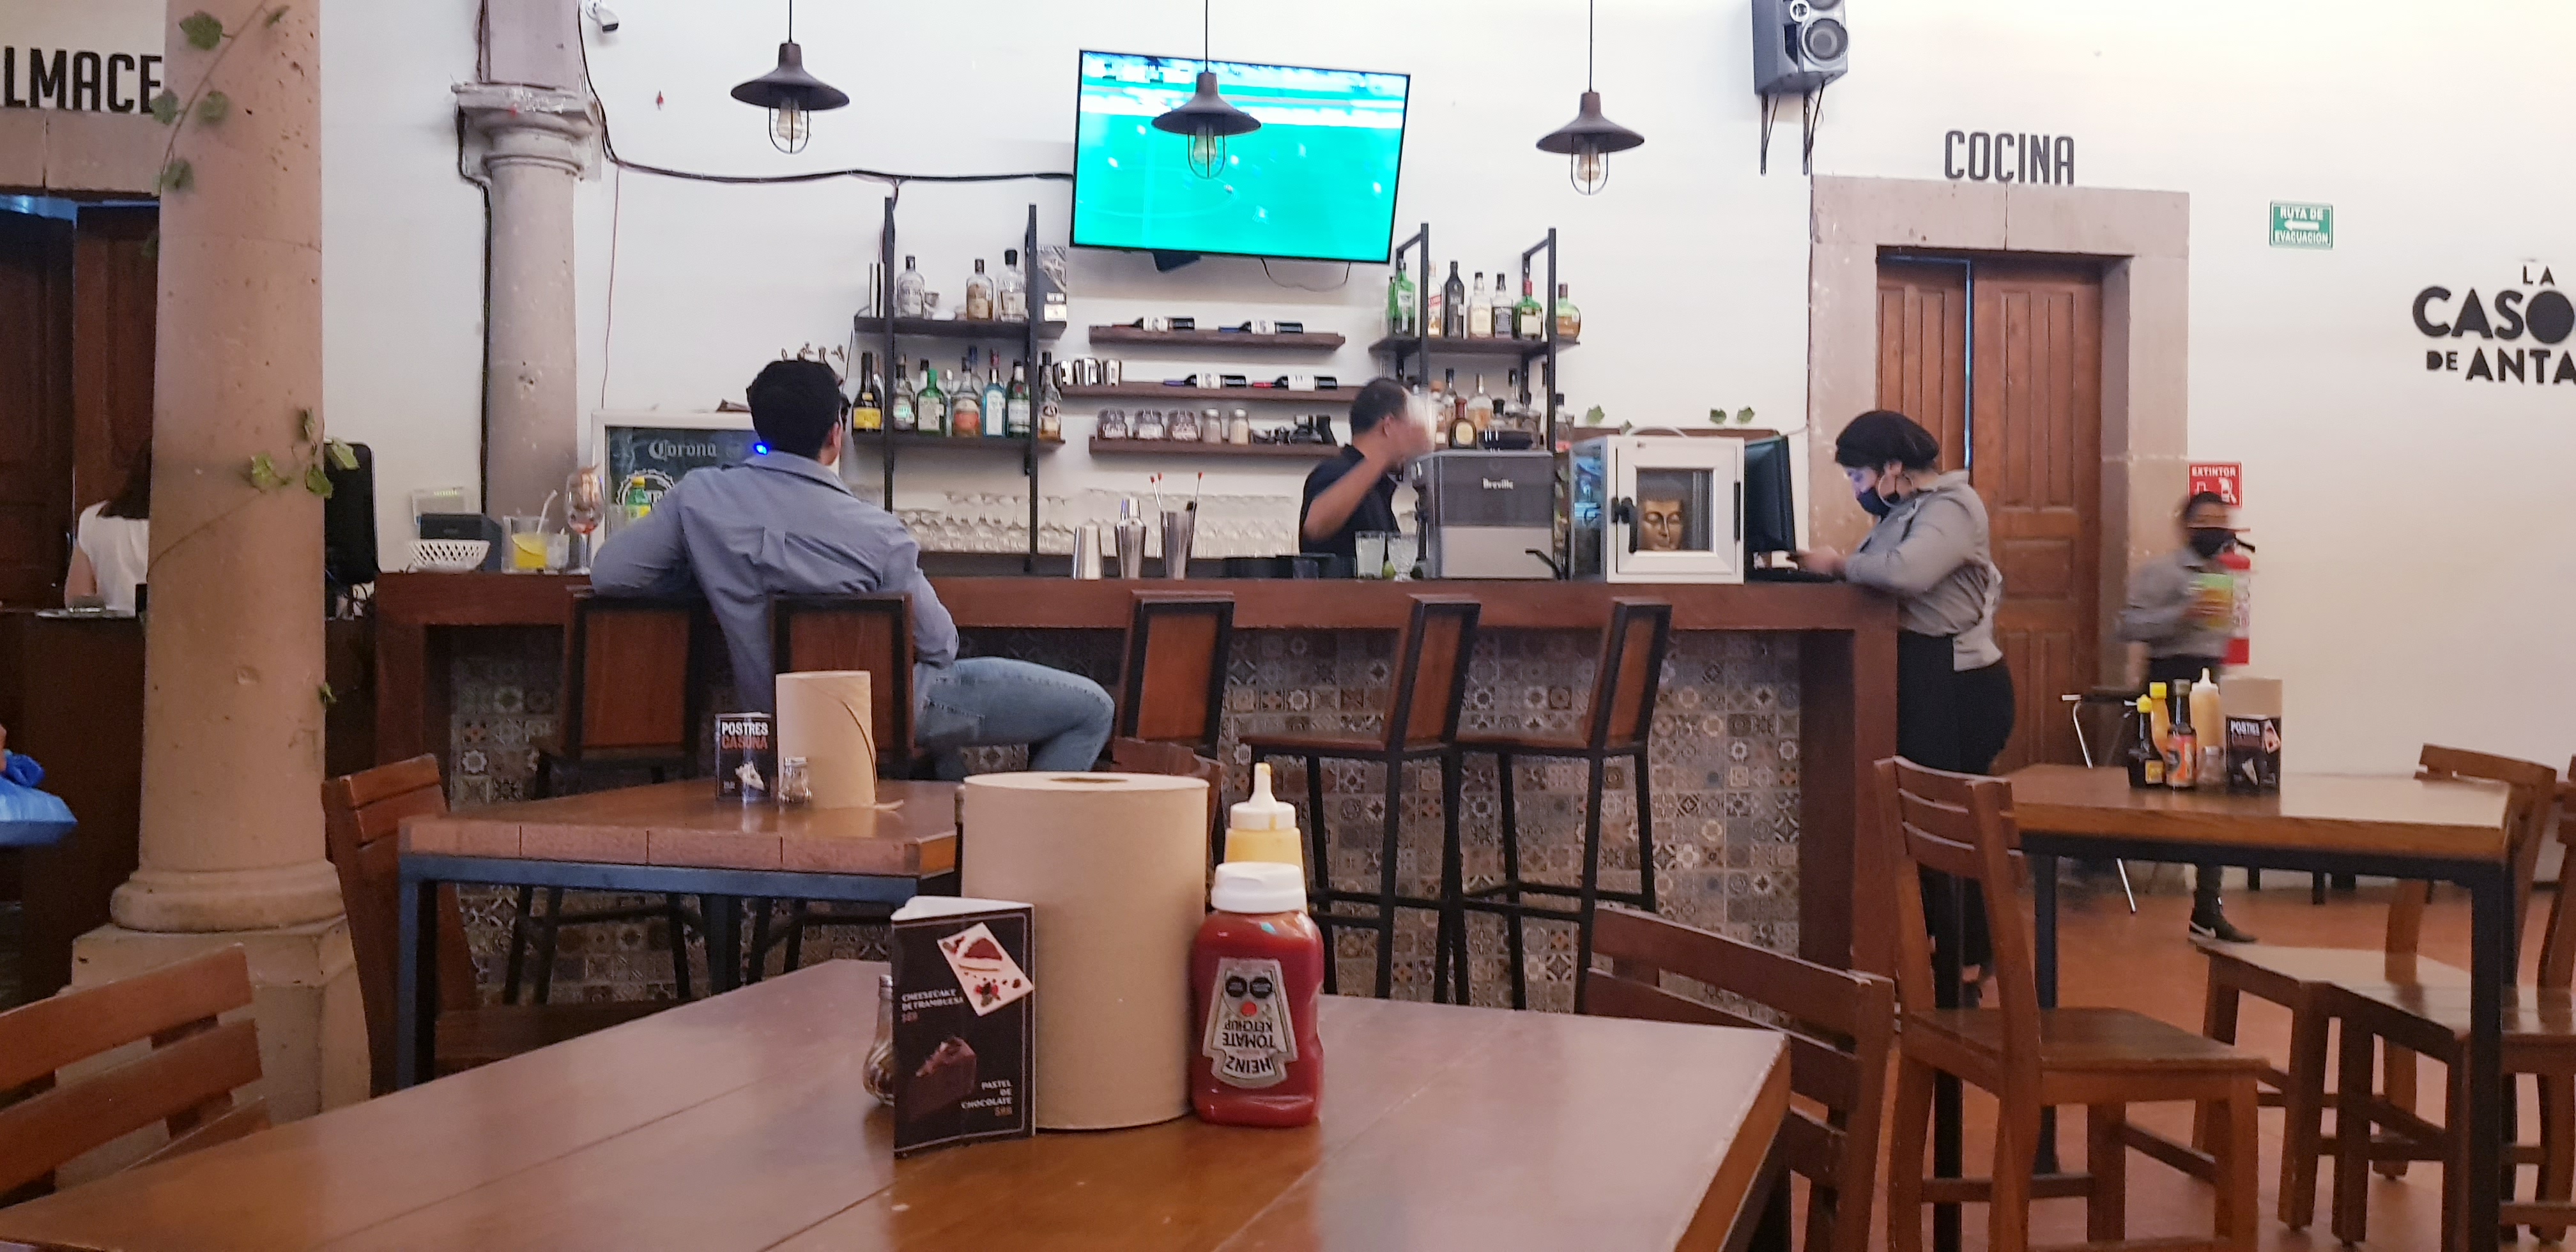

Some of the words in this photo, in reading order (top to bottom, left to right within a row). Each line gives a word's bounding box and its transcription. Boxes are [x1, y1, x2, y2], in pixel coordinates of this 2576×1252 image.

[1945, 130, 2074, 186] COCINA
[2280, 206, 2307, 220] RUTA
[2310, 207, 2324, 220] DE
[2523, 264, 2555, 286] LA
[2412, 286, 2575, 345] CASO
[2426, 349, 2458, 370] DE
[2465, 346, 2576, 385] ANTA
[648, 439, 717, 462] Corona
[2191, 466, 2236, 477] EXTINTOR
[1482, 477, 1514, 490] Breville
[721, 721, 769, 737] POSTRES
[901, 989, 956, 1002] CHEESECAKE
[1222, 1019, 1273, 1033] KETCHUP
[1222, 1032, 1275, 1048] TOMATE
[1225, 1055, 1272, 1074] HEINZ
[981, 1080, 1013, 1090] PASTEL
[1000, 1088, 1013, 1097] DE
[960, 1097, 1013, 1109] CHOCOLATE
